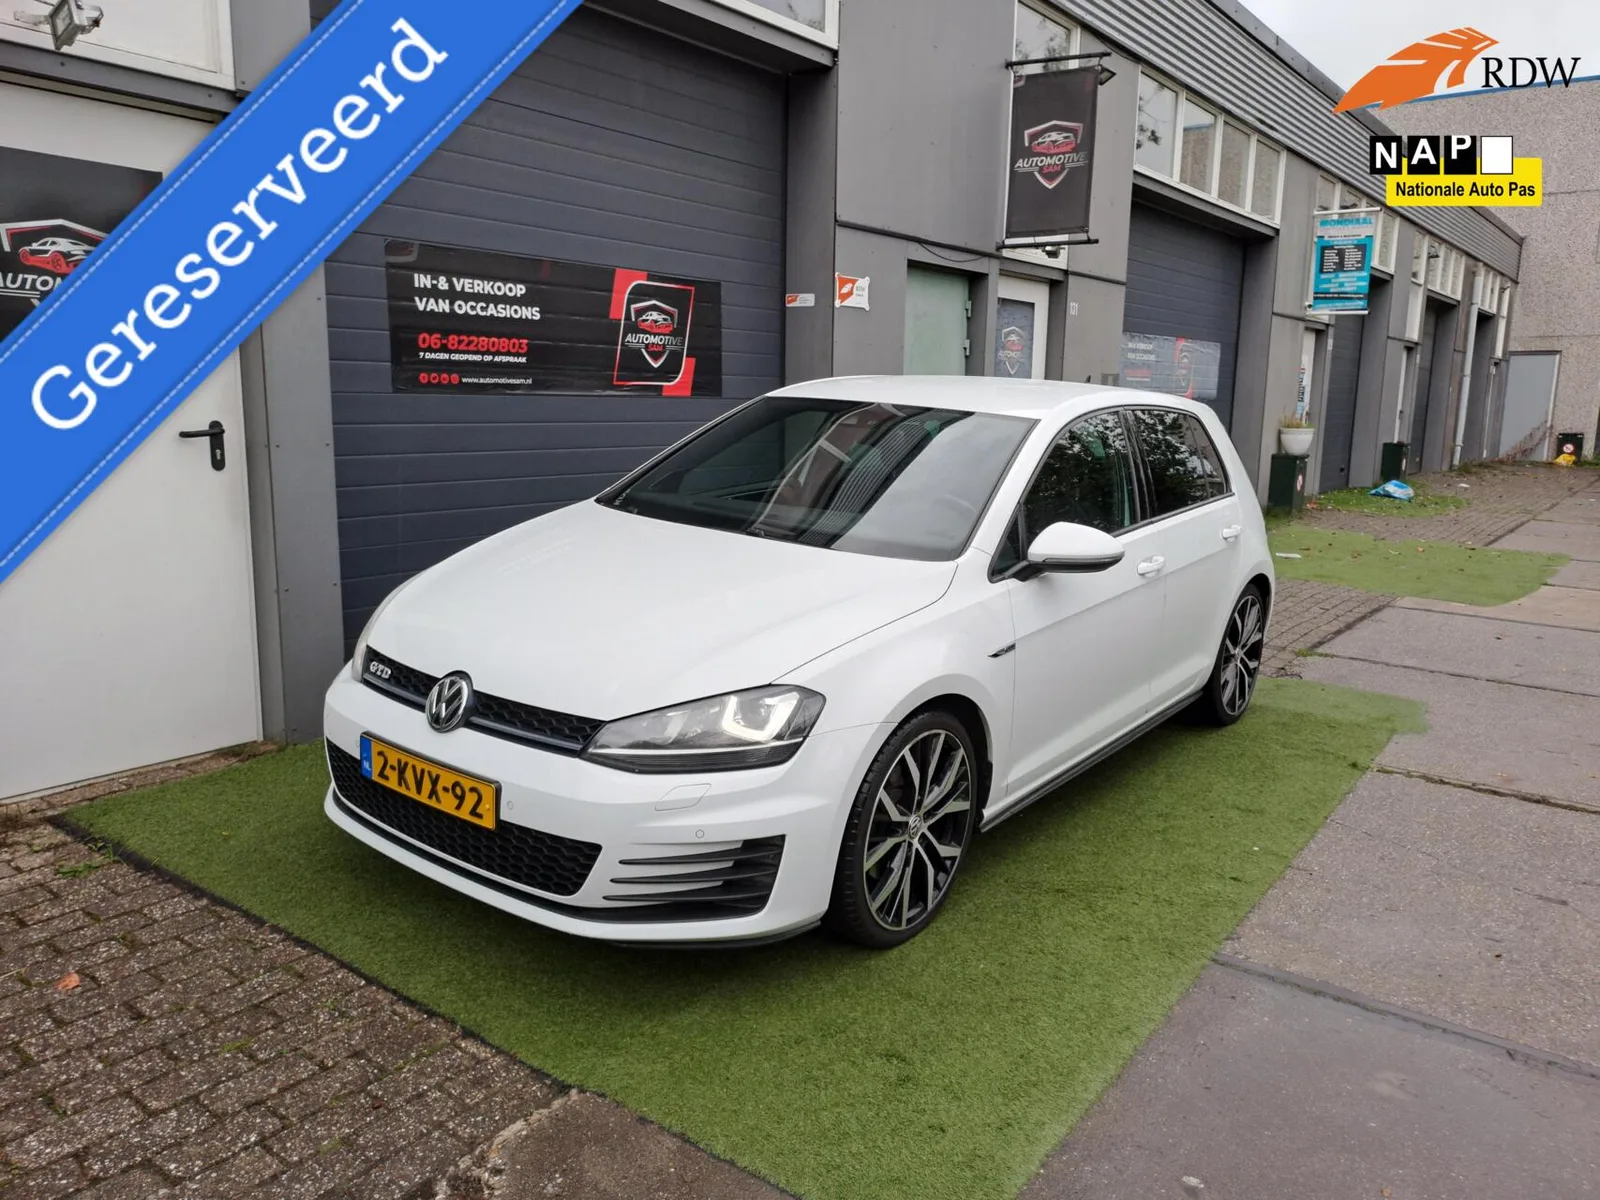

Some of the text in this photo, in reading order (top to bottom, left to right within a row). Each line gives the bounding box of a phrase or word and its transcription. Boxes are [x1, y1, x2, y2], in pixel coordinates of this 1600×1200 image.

[1015, 152, 1087, 168] AUTOMOTIVE
[413, 273, 526, 298] IN-& VERKOOP
[414, 297, 541, 320] VAN OCCASIONS
[418, 332, 528, 353] 06-82280803
[625, 334, 683, 345] AUTOMOTIVE
[425, 352, 449, 360] DAGEN
[450, 353, 482, 362] GEOPEND
[493, 355, 527, 364] AFSPRAAK
[461, 376, 533, 385] www.automotivesam.nl
[370, 661, 391, 678] GTD
[377, 751, 484, 819] 2-KVX-92
